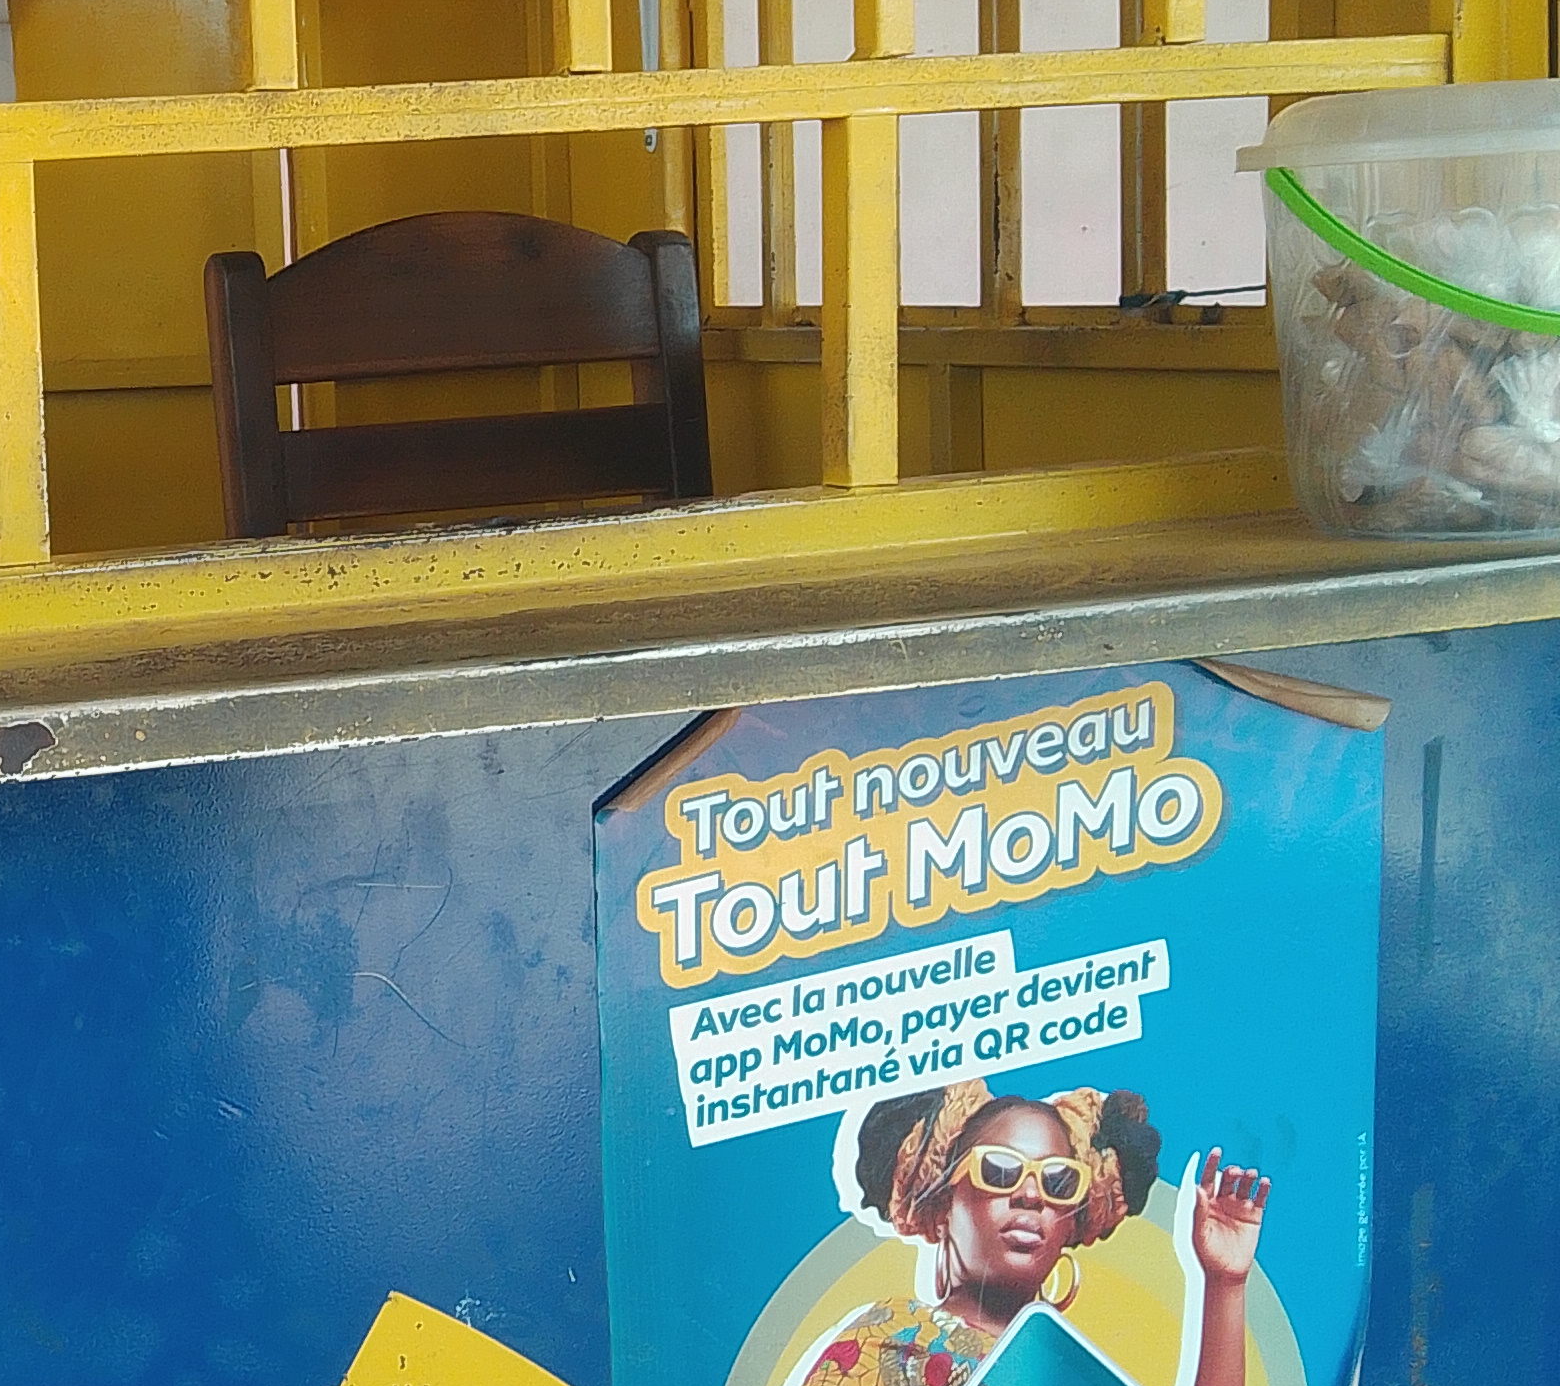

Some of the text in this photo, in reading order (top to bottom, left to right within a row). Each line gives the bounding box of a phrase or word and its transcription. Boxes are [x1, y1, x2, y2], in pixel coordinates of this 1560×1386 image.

[682, 700, 1153, 853] Tout nouveau
[653, 767, 1202, 965] Tout MoMo
[690, 947, 997, 1041] Avec la nouvelle
[690, 954, 1157, 1088] app MoMo, payer devient
[695, 1002, 1128, 1128] instantané via QR code
